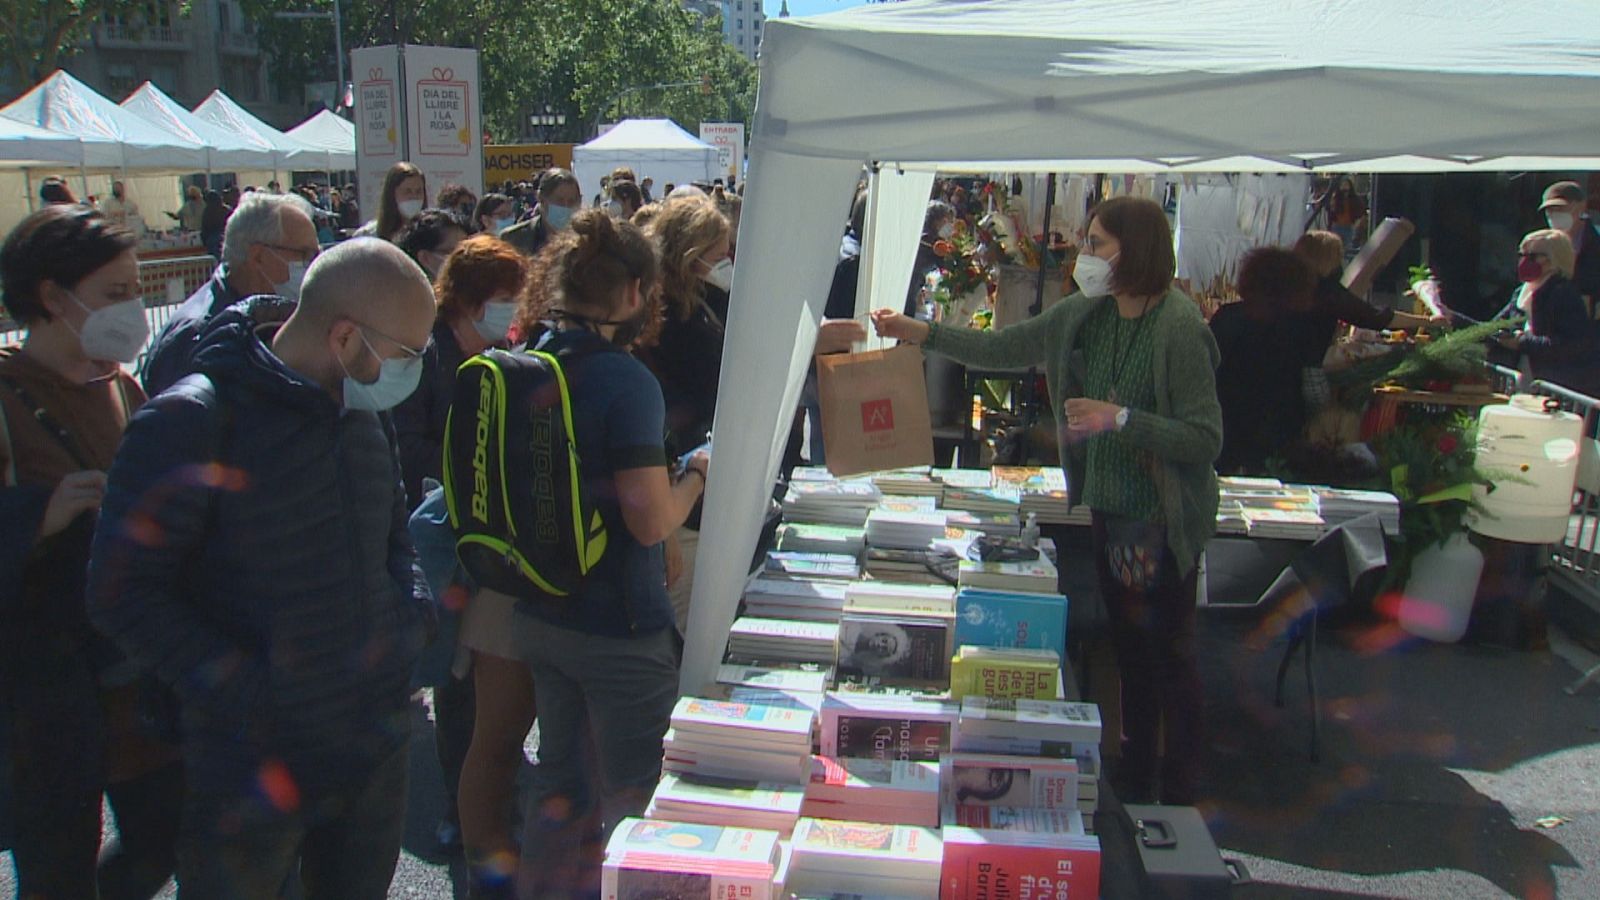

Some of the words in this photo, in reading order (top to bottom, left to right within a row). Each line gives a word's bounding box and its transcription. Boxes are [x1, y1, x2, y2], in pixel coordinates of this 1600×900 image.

[423, 89, 439, 99] DIA
[441, 90, 461, 100] DEL
[425, 100, 459, 111] LLIBRE
[438, 110, 452, 120] LA
[430, 121, 457, 131] ROSA
[998, 669, 1012, 691] les
[1011, 671, 1025, 690] de
[1037, 671, 1051, 690] La
[924, 736, 940, 757] Un
[1056, 859, 1073, 875] El
[739, 885, 752, 898] El
